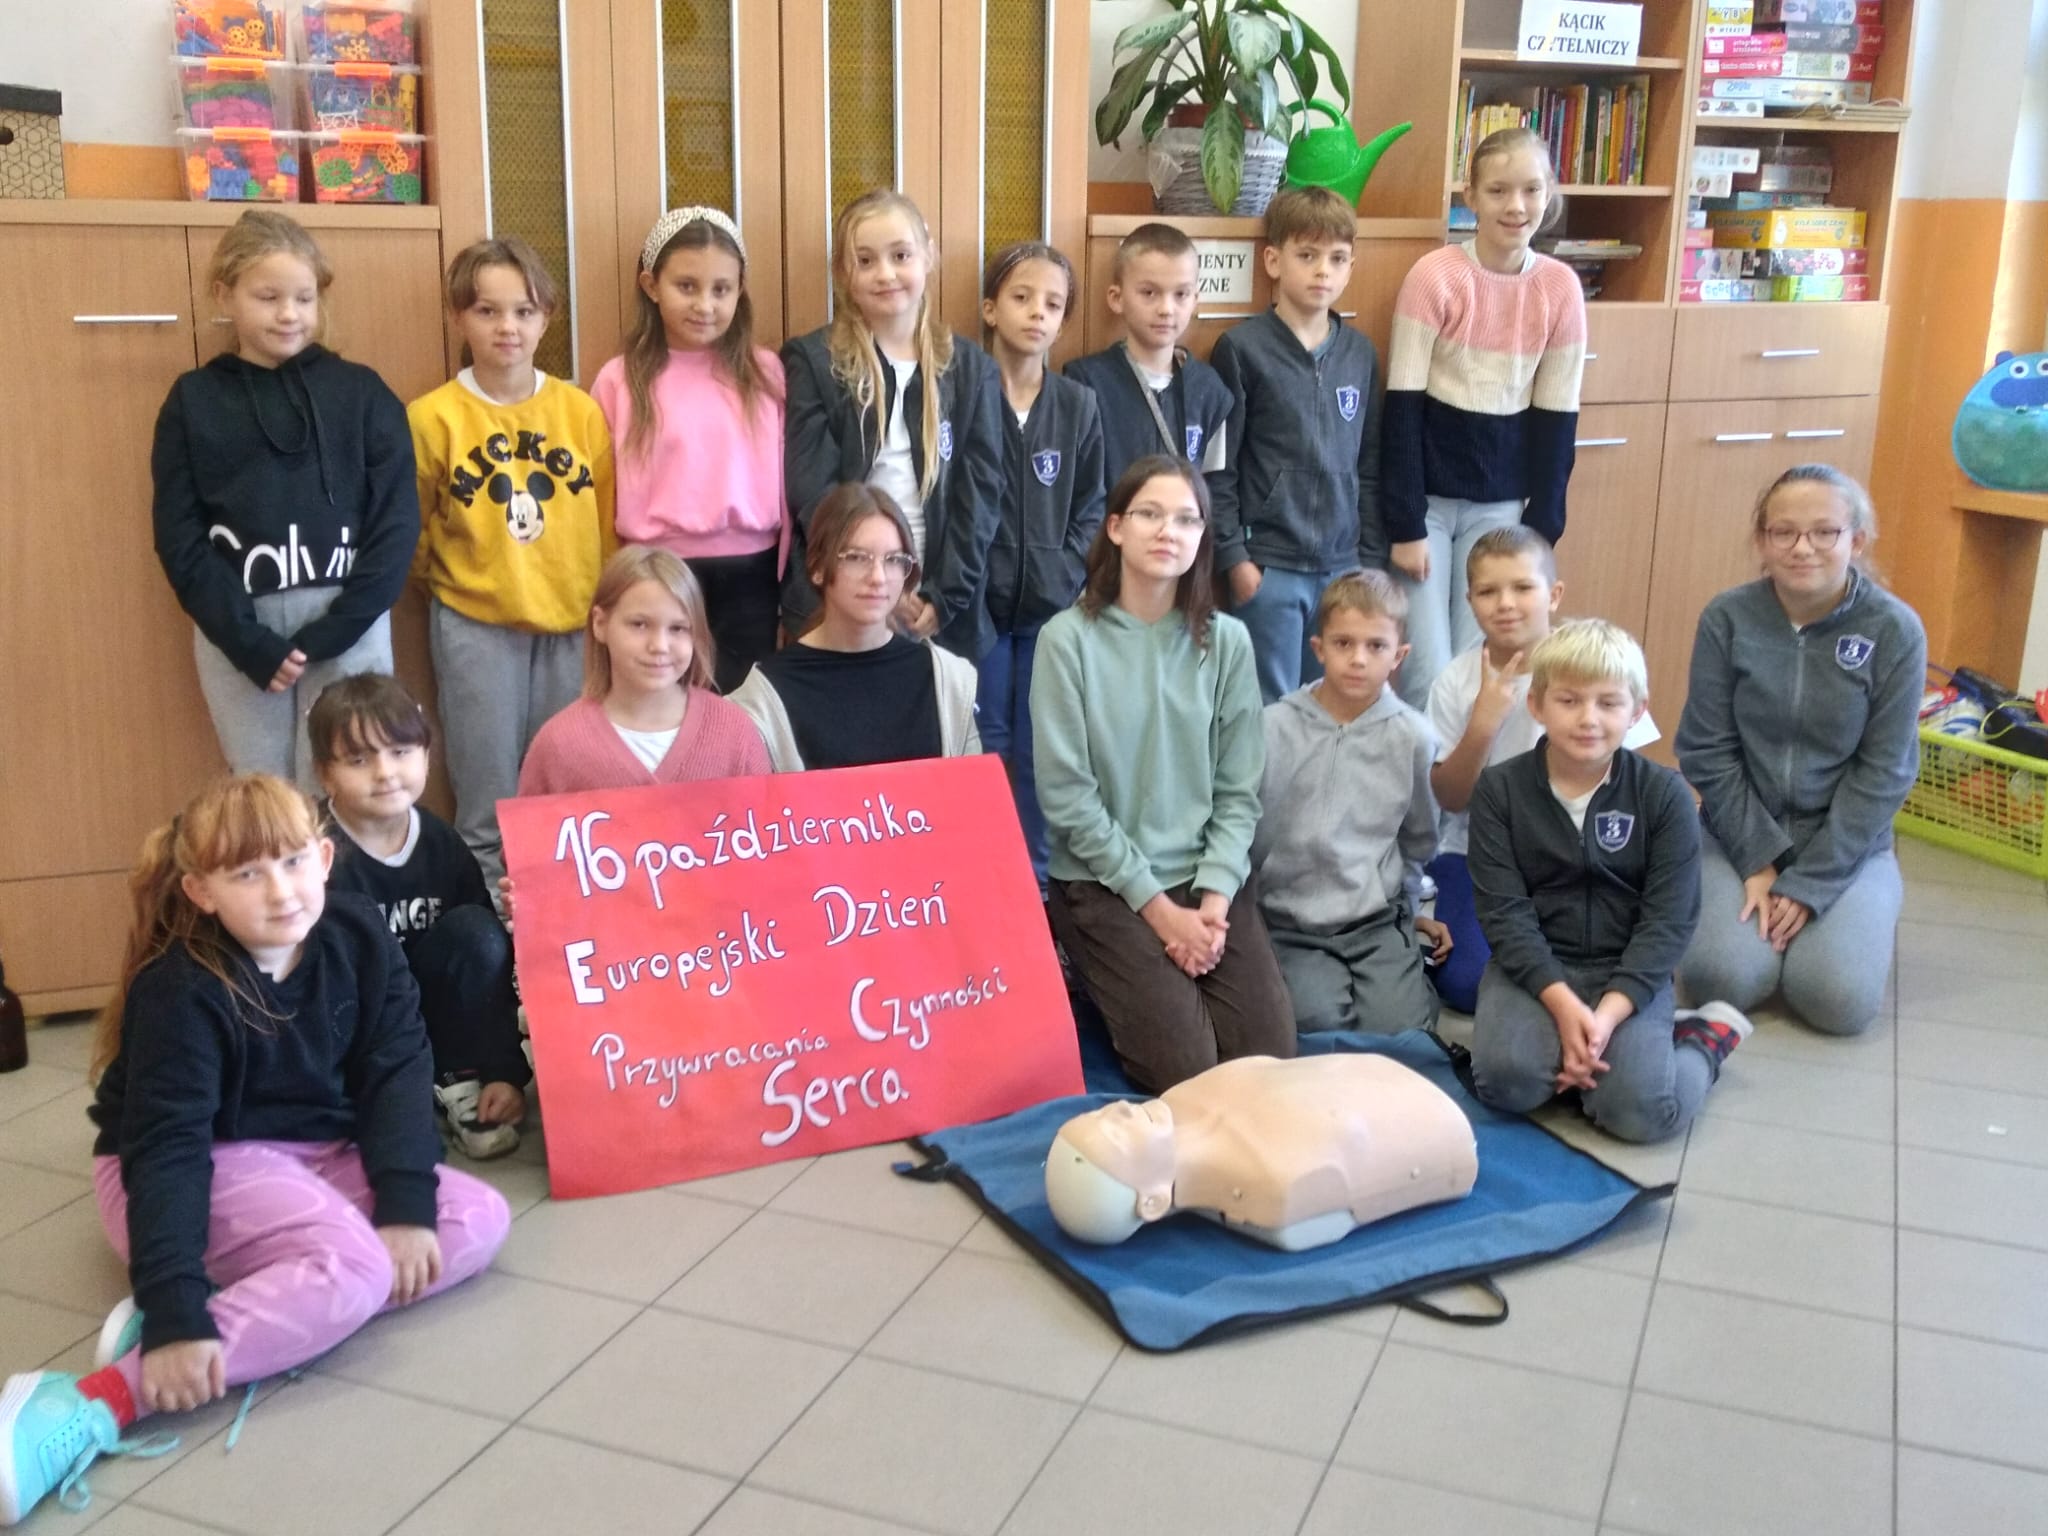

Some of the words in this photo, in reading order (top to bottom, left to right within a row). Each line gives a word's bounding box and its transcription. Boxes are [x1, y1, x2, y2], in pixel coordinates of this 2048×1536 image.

[1558, 12, 1606, 33] KĄCIK
[1198, 254, 1247, 270] ENTY
[1199, 278, 1230, 293] ZNE
[556, 812, 626, 897] 16
[636, 793, 931, 909] października
[378, 897, 442, 934] NGE
[565, 912, 785, 1003] Europejski
[814, 883, 946, 945] Dzień
[592, 1033, 827, 1108] Przywracania
[851, 967, 1007, 1049] Czynności
[762, 1059, 908, 1145] Serca
